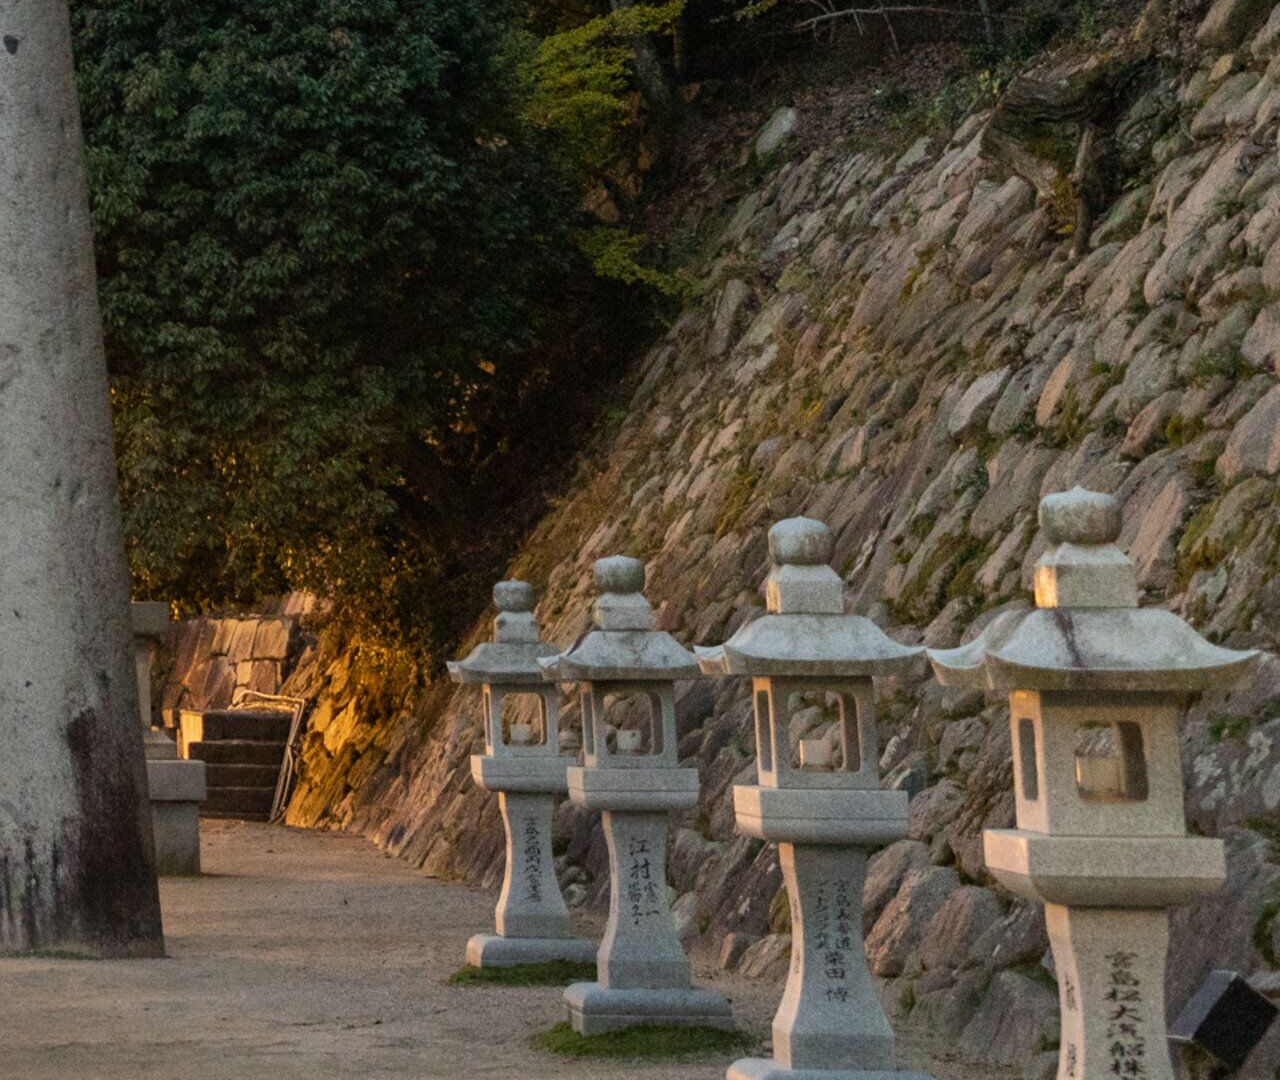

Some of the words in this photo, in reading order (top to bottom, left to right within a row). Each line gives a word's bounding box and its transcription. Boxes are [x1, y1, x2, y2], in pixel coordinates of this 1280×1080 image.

[1104, 951, 1146, 1080] 宮島松大汽船株
